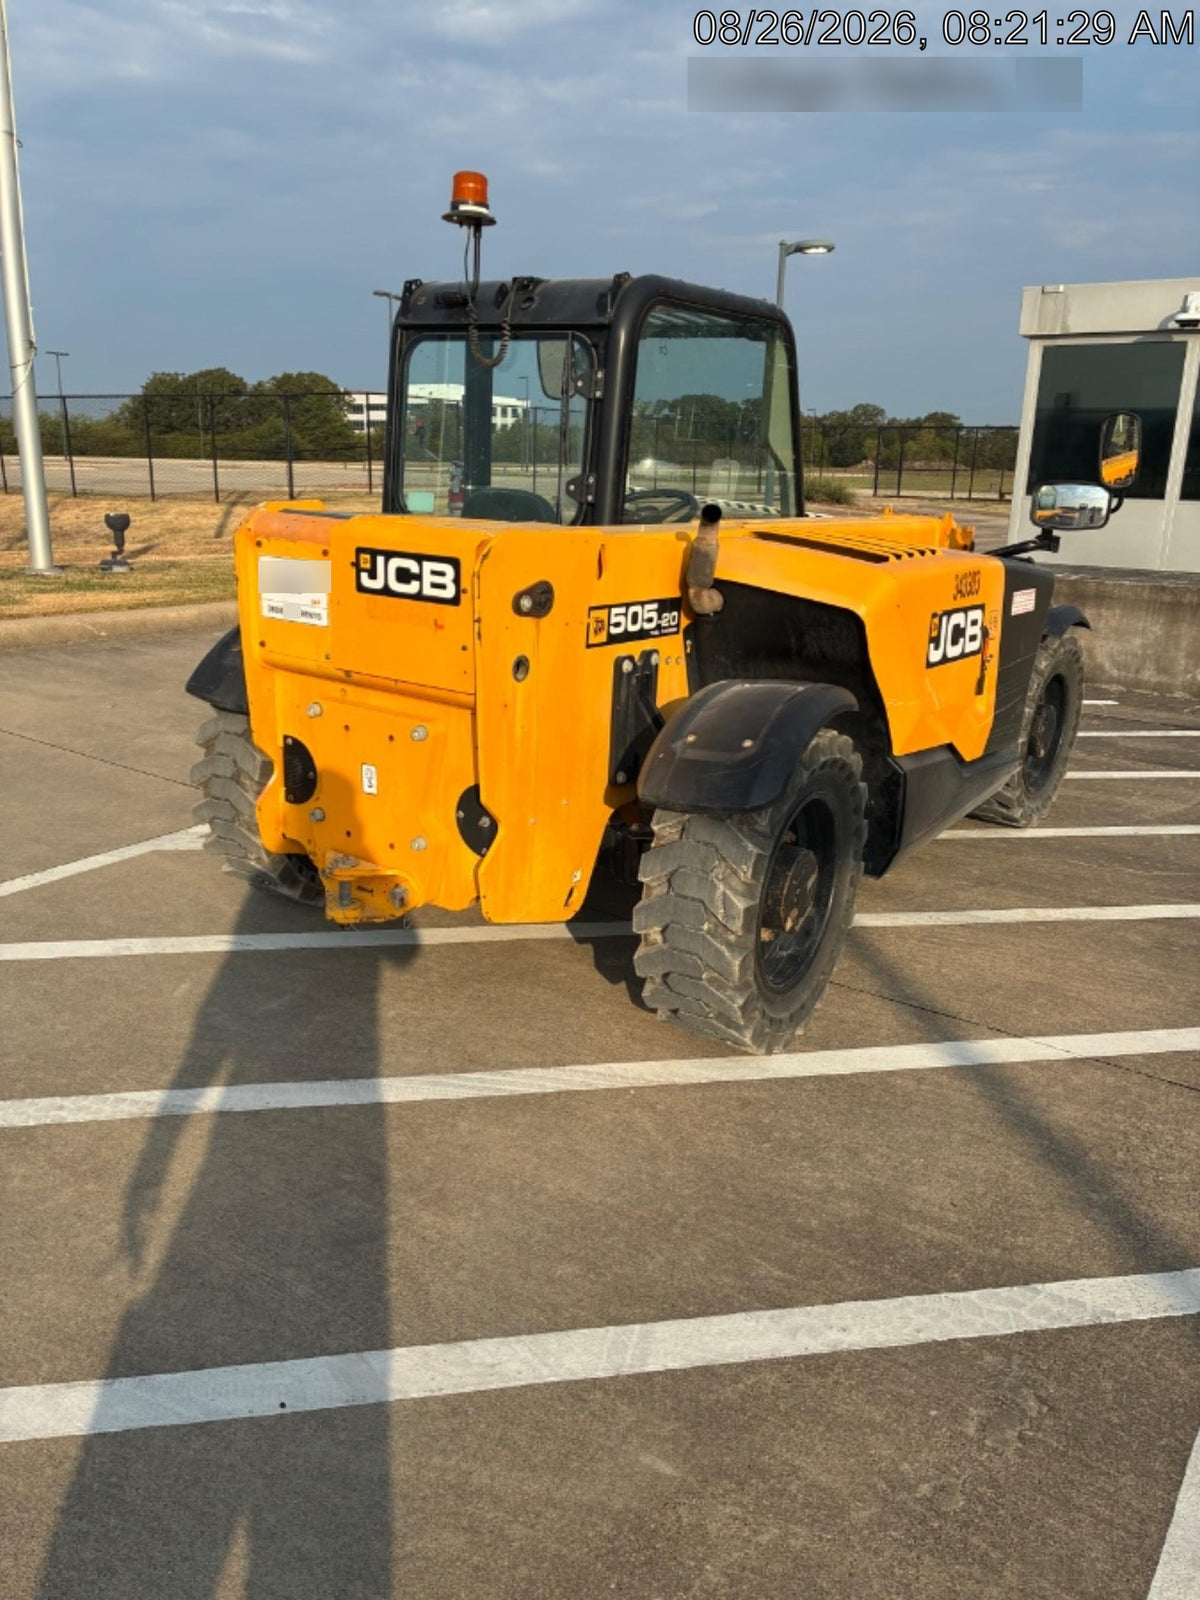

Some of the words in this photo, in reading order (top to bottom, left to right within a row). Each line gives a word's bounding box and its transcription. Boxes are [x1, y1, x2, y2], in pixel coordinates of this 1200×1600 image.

[360, 555, 456, 599] JCB
[609, 602, 679, 635] 505-20
[928, 608, 983, 664] JCB
